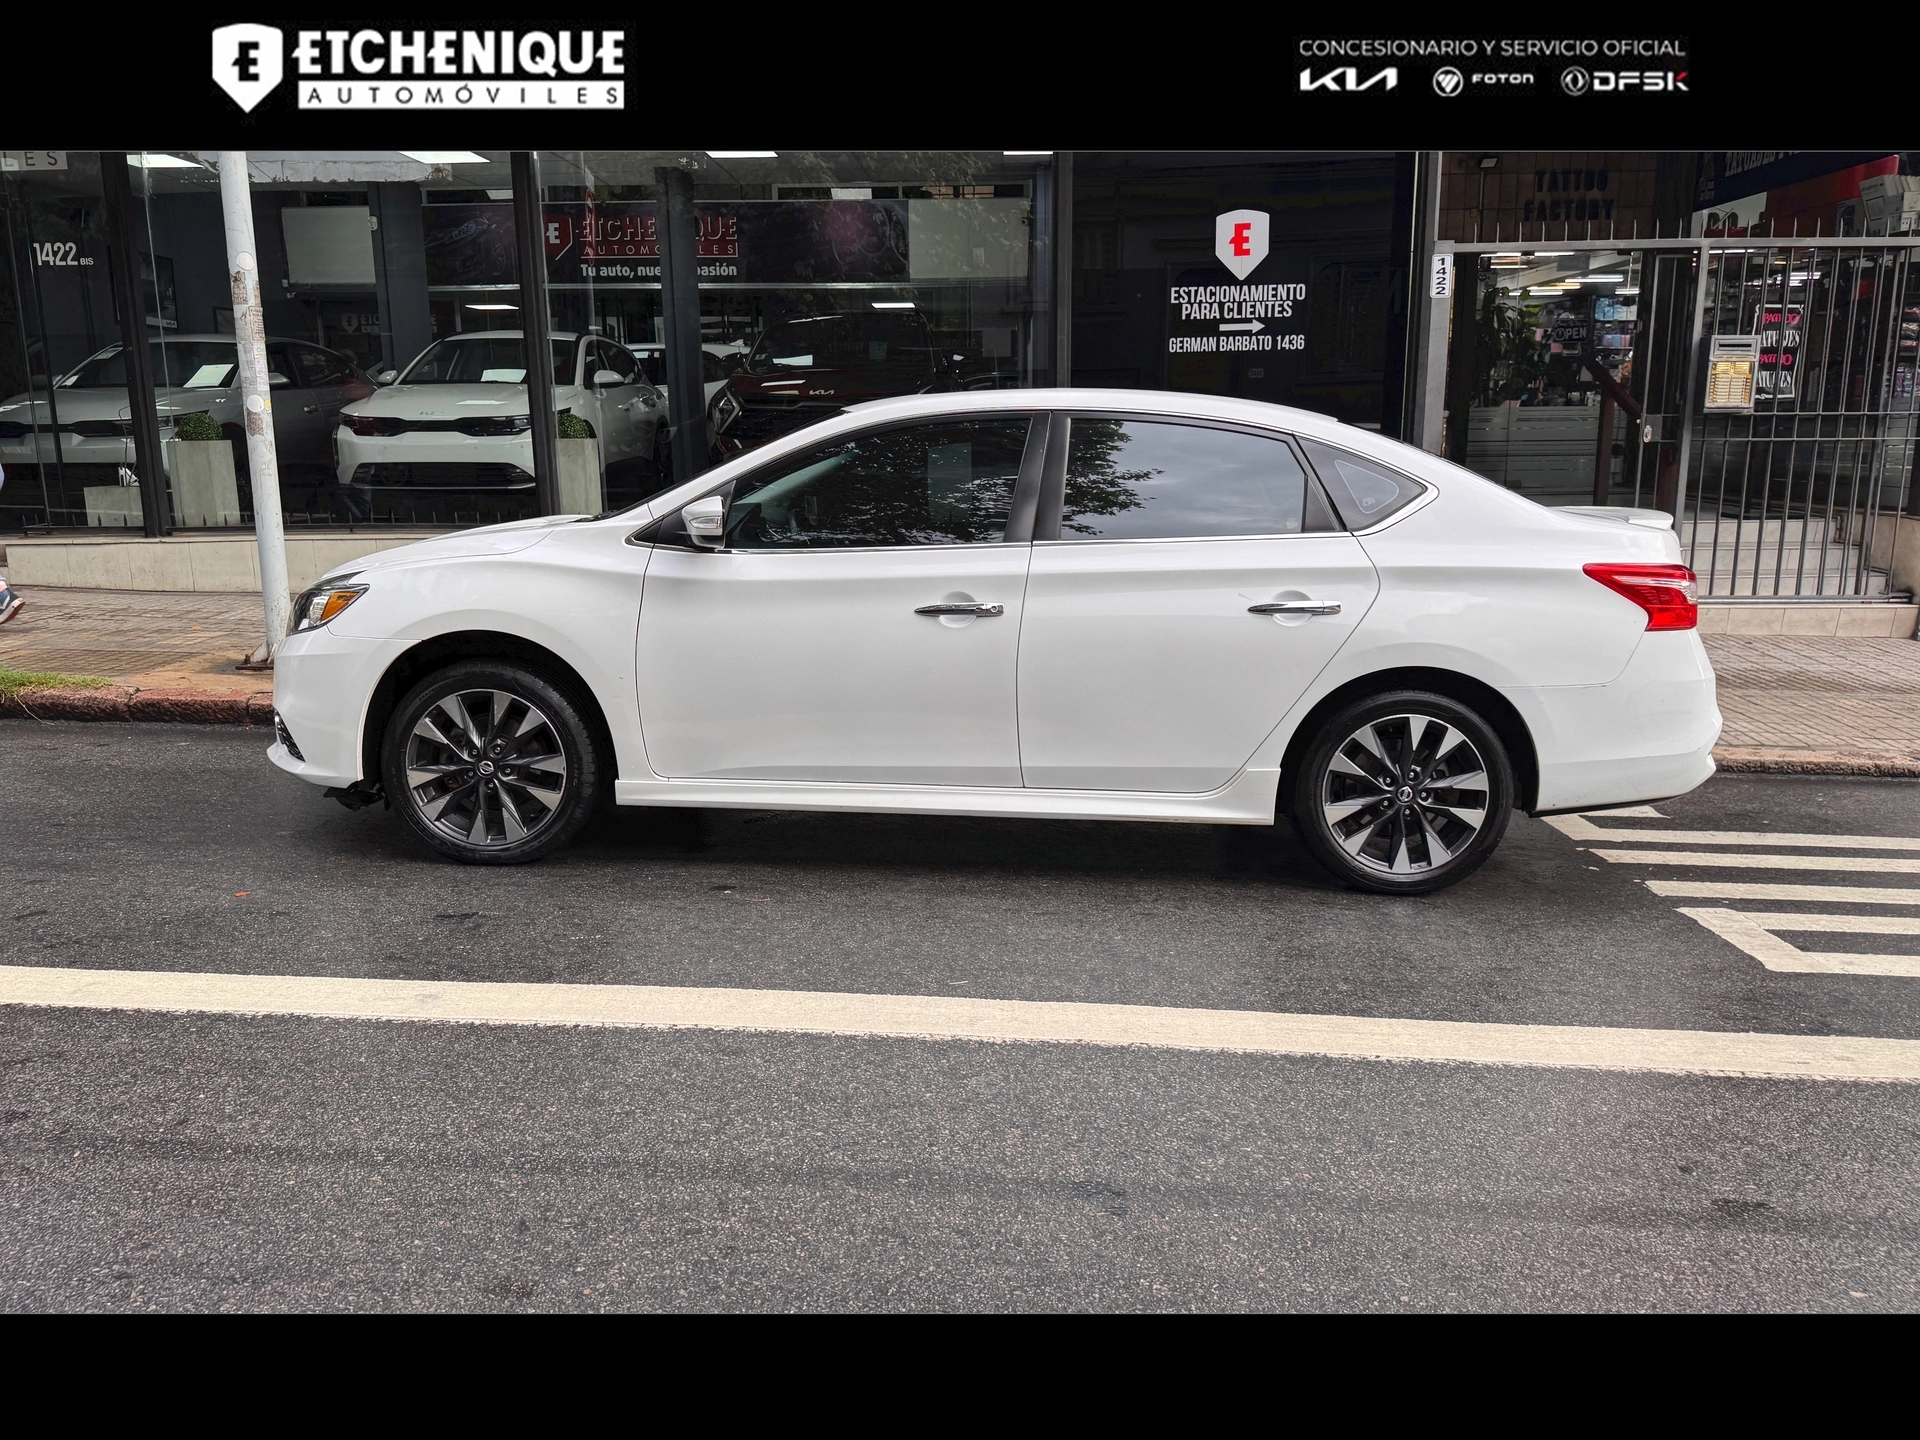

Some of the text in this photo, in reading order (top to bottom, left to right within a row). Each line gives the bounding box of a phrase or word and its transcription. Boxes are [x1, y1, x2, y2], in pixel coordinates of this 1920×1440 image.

[1536, 168, 1608, 192] TATTOO
[1523, 198, 1615, 221] FACTORY
[575, 216, 738, 241] ETCHEQUE
[33, 242, 94, 266] 1422 BIS
[581, 264, 596, 277] Tu
[600, 265, 634, 278] auto,
[1435, 257, 1448, 295] 1422
[1170, 284, 1306, 303] ESTACIONAMIENTO
[1181, 301, 1293, 320] PARA CLIENTES
[1554, 326, 1587, 341] OPEN
[1760, 330, 1801, 347] ATUJES
[1169, 334, 1305, 353] GERMAN BARBATO 1436
